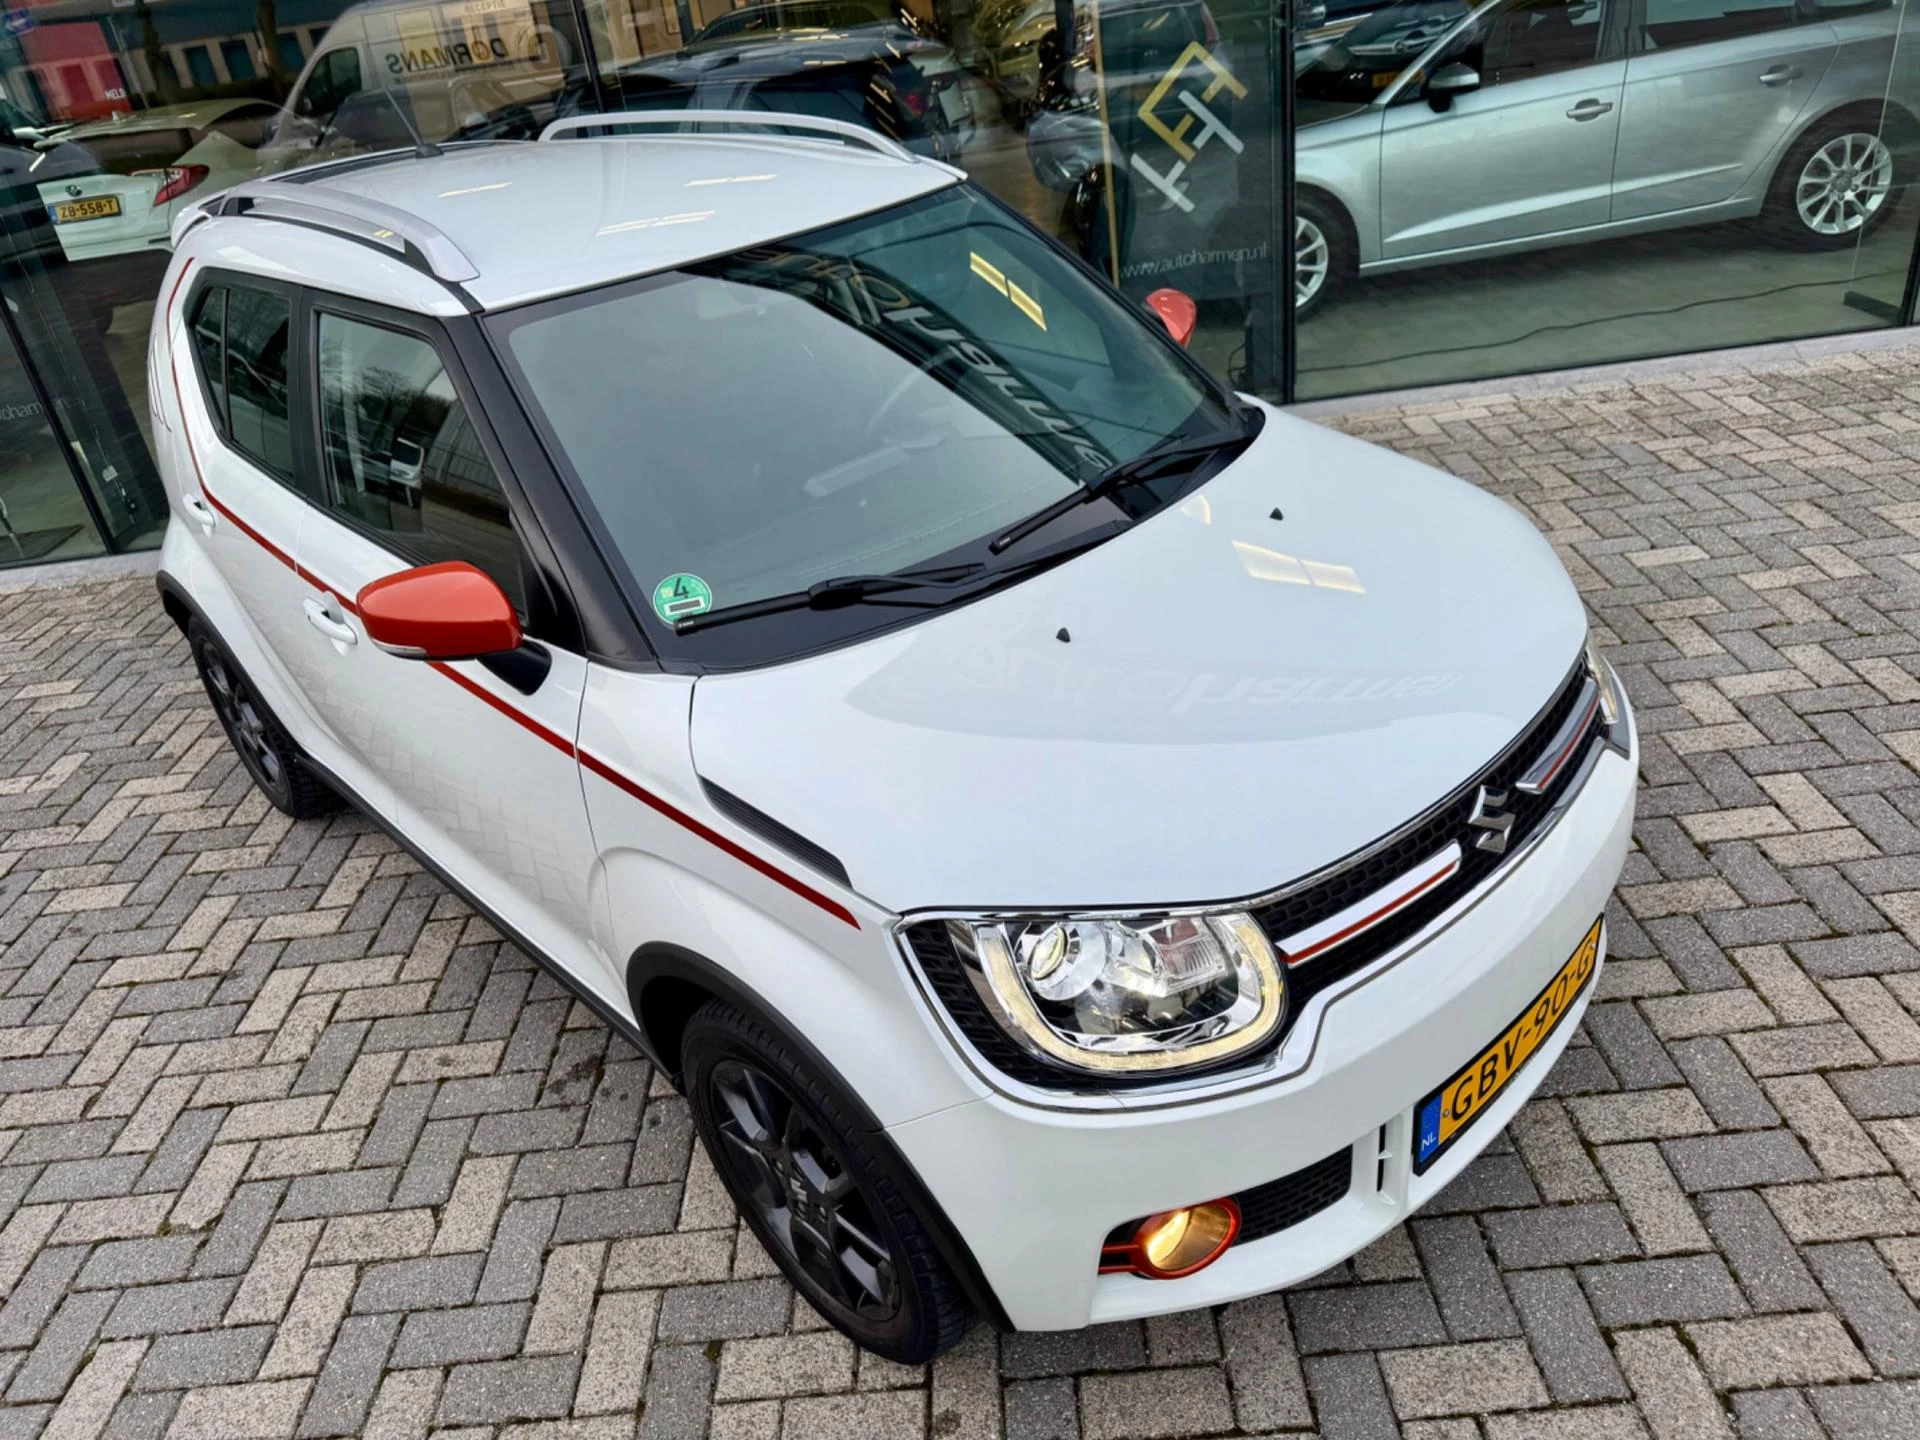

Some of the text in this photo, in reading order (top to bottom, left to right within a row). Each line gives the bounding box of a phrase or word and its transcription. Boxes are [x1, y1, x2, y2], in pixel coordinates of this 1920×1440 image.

[60, 199, 114, 219] ZB-558-T
[673, 577, 689, 599] 4
[1451, 936, 1593, 1121] GBV-90-G
[1420, 1133, 1437, 1152] NL
